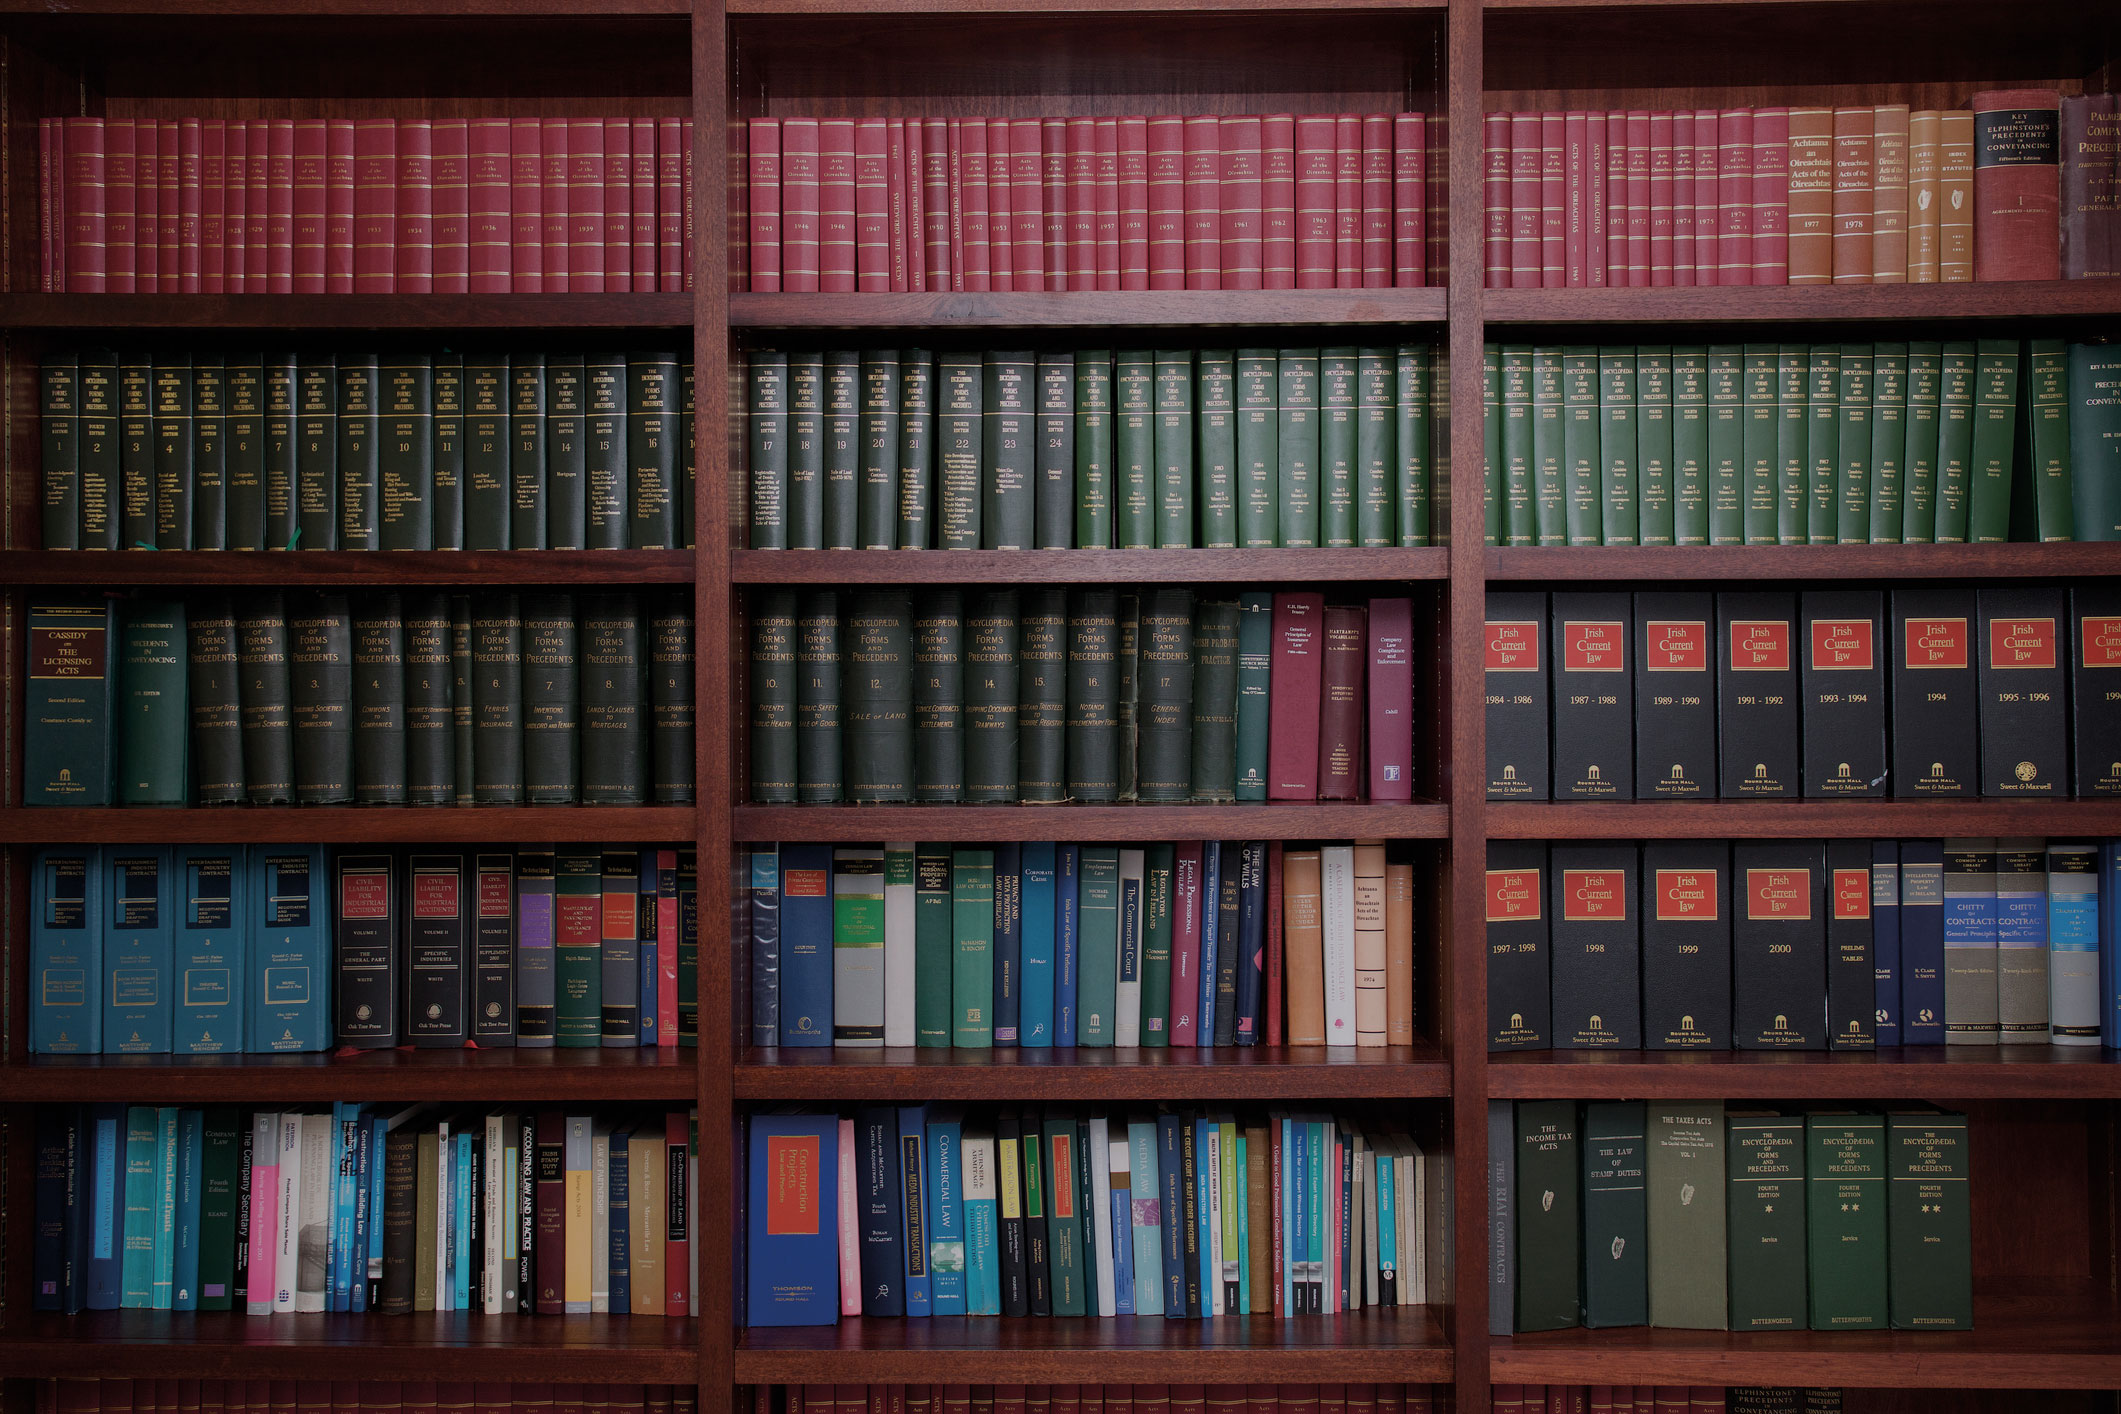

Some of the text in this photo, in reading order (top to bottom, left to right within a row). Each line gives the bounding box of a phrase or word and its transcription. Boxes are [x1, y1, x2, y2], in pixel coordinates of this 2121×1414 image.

[1987, 143, 2050, 151] CONVEYANCING
[1791, 180, 1830, 188] Oireachtas
[57, 443, 61, 451] 1
[94, 443, 100, 452] 2
[133, 443, 140, 452] 3
[205, 443, 211, 452] 5
[311, 443, 317, 452] 8
[400, 443, 409, 452] 10
[483, 443, 492, 452] 12
[562, 443, 571, 452] 14
[649, 439, 657, 448] 16
[763, 441, 772, 450] 17
[872, 439, 884, 448] 20
[956, 439, 969, 448] 22
[1004, 440, 1016, 449] 23
[1049, 439, 1062, 448] 24
[1585, 628, 1604, 639] Irish
[1926, 625, 1947, 636] Irish
[861, 635, 889, 644] FORMS
[1381, 638, 1402, 646] Company
[1918, 637, 1954, 648] Current
[1576, 640, 1611, 651] Current
[852, 652, 898, 662] PRECEDENTS
[1587, 653, 1601, 663] Law
[1929, 650, 1944, 660] Law
[1570, 696, 1588, 704] 1987
[1598, 696, 1616, 704] 1988
[1927, 693, 1946, 701] 1994
[1999, 693, 2019, 702] 1995
[2029, 693, 2049, 702] 1996
[1151, 704, 1180, 713] GENERAL
[850, 712, 870, 720] SALE
[885, 712, 906, 720] LAND
[1154, 715, 1176, 724] INDEX
[1243, 849, 1250, 861] OF
[1251, 849, 1260, 887] THE LAW
[1585, 876, 1604, 887] Irish
[1576, 889, 1612, 899] Current
[1587, 901, 1602, 912] Law
[1946, 918, 1996, 926] CONTRACTS
[1126, 887, 1136, 975] The Commercial Court
[1585, 944, 1604, 953] 1998
[1678, 945, 1698, 954] 1999
[1769, 944, 1791, 953] 2000
[1697, 1117, 1711, 1125] ACTS
[360, 1130, 368, 1173] Construction
[1539, 1143, 1557, 1151] ACTS
[523, 1126, 532, 1178] ACCOUNTING
[788, 1150, 797, 1188] Projects
[164, 1120, 176, 1232] The Modern Law of Trusts
[239, 1131, 253, 1236] The Company Secretary
[799, 1149, 808, 1213] Construction
[939, 1135, 951, 1227] COMMERCIAL LAW
[523, 1178, 532, 1195] LAW
[357, 1189, 365, 1218] Building
[523, 1196, 532, 1214] AND
[909, 1195, 919, 1226] INDUSTRY
[522, 1216, 532, 1251] PRACTICE
[910, 1226, 921, 1272] TRANSACTIONS
